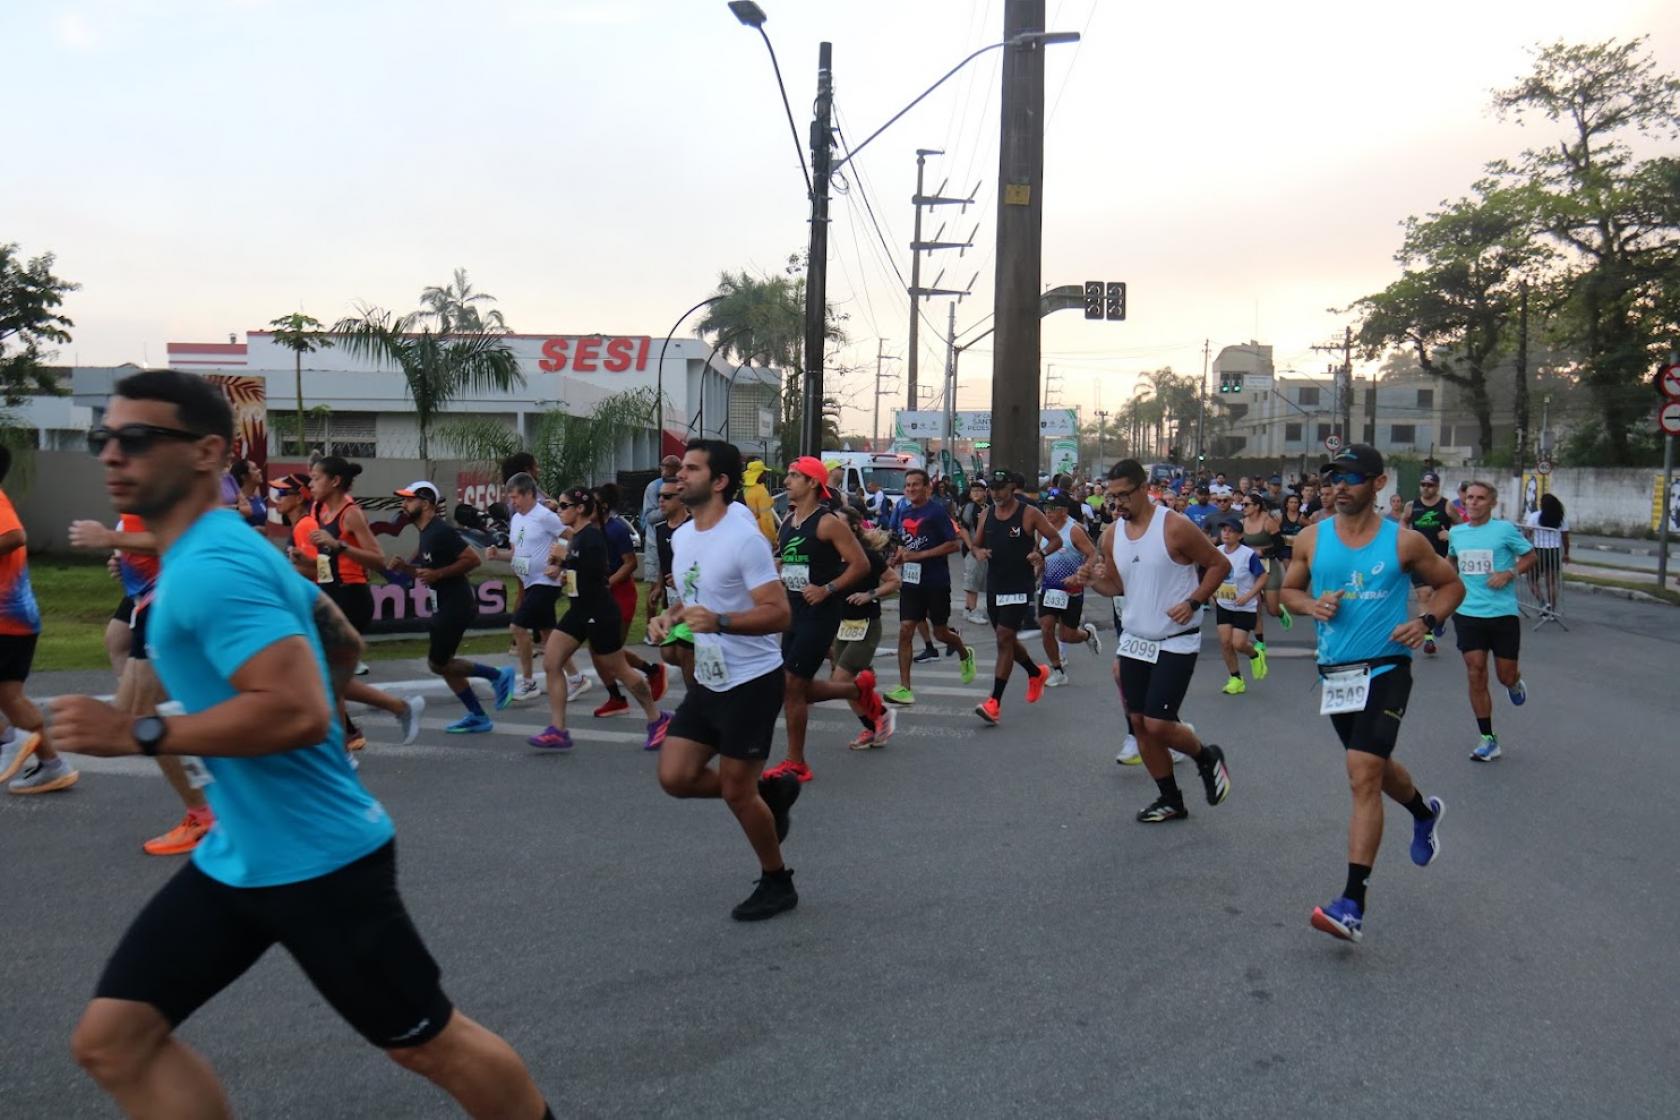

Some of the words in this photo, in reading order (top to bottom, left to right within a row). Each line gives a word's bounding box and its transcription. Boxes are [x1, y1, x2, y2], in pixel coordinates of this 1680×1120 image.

[538, 335, 651, 373] SESI
[1461, 560, 1492, 572] 2919
[370, 577, 505, 620] nts
[1121, 639, 1157, 659] 2099
[1326, 686, 1366, 708] 2549
